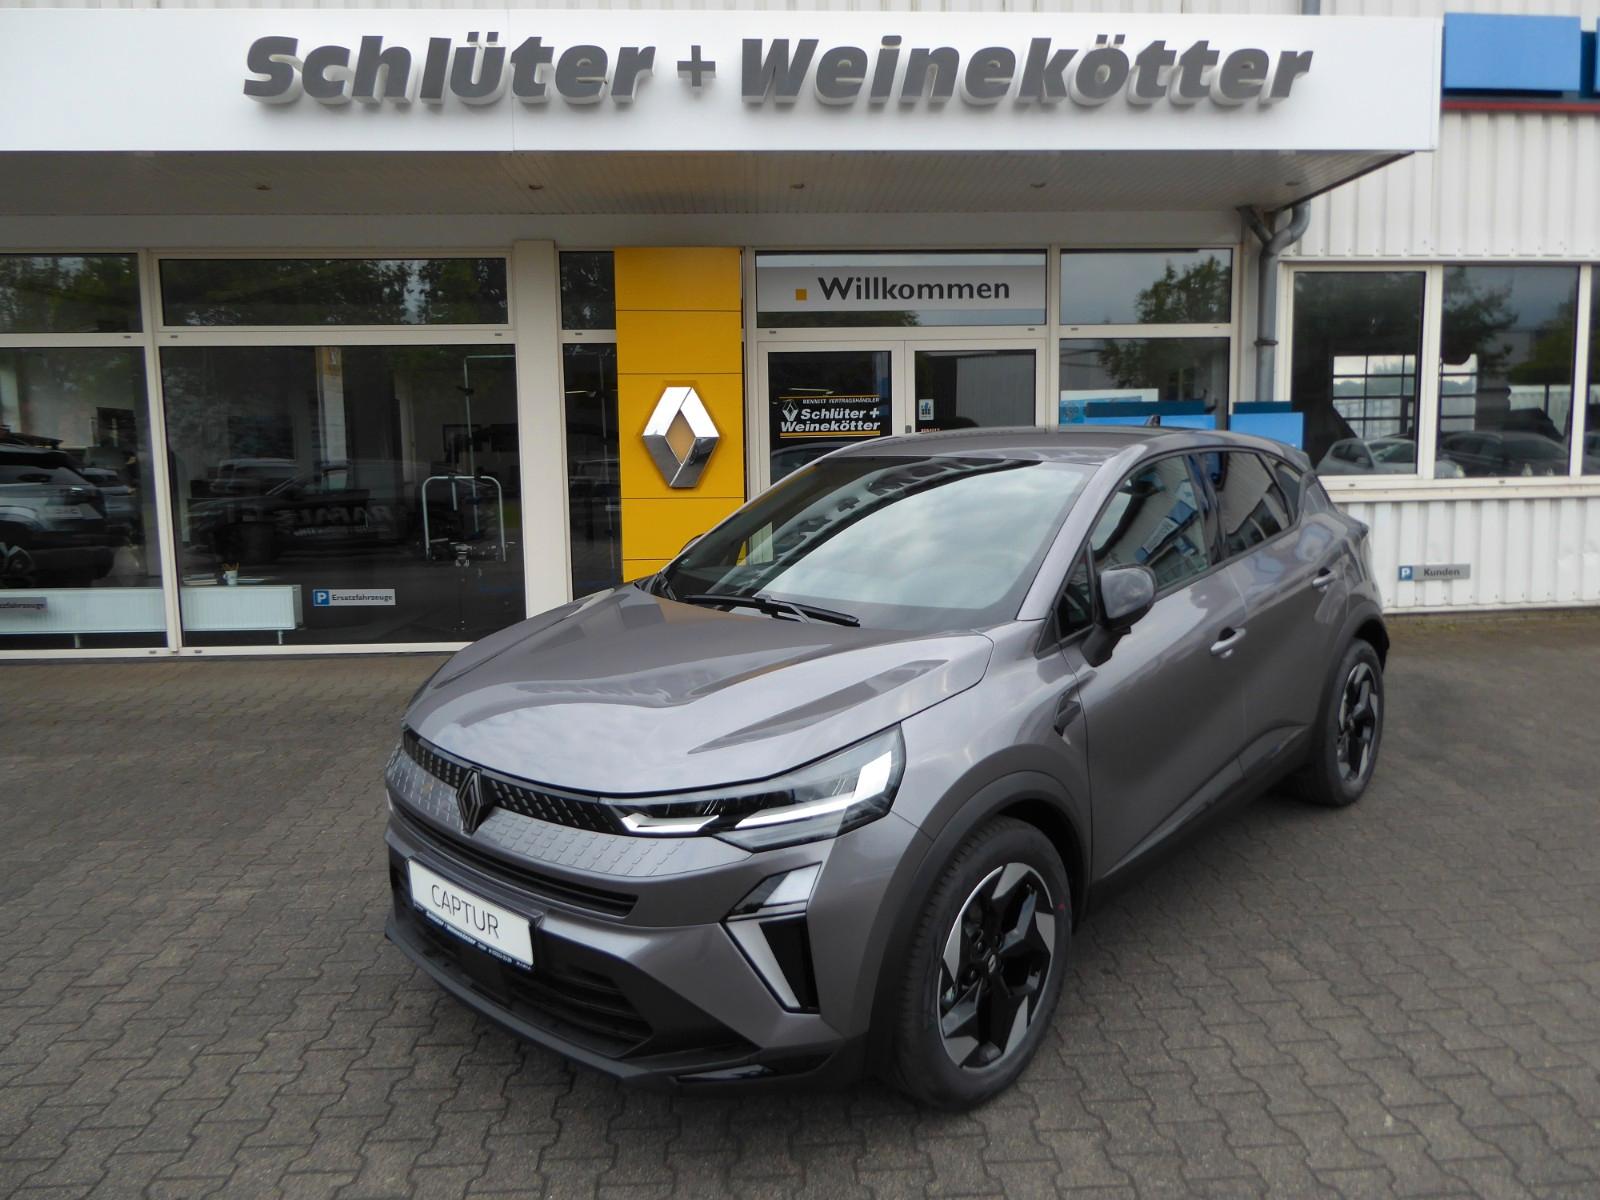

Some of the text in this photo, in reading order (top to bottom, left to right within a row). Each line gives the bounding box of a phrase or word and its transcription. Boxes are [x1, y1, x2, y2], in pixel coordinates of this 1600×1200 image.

[243, 31, 1314, 106] Schlüter + Weinekötter
[818, 276, 1010, 301] Willkommen
[801, 407, 880, 420] Schlüter +
[781, 420, 880, 432] Weinekötter
[1401, 567, 1461, 578] P Kunden
[317, 592, 393, 604] P Ersatzfahrzeuge
[431, 884, 500, 939] CAPTUR
